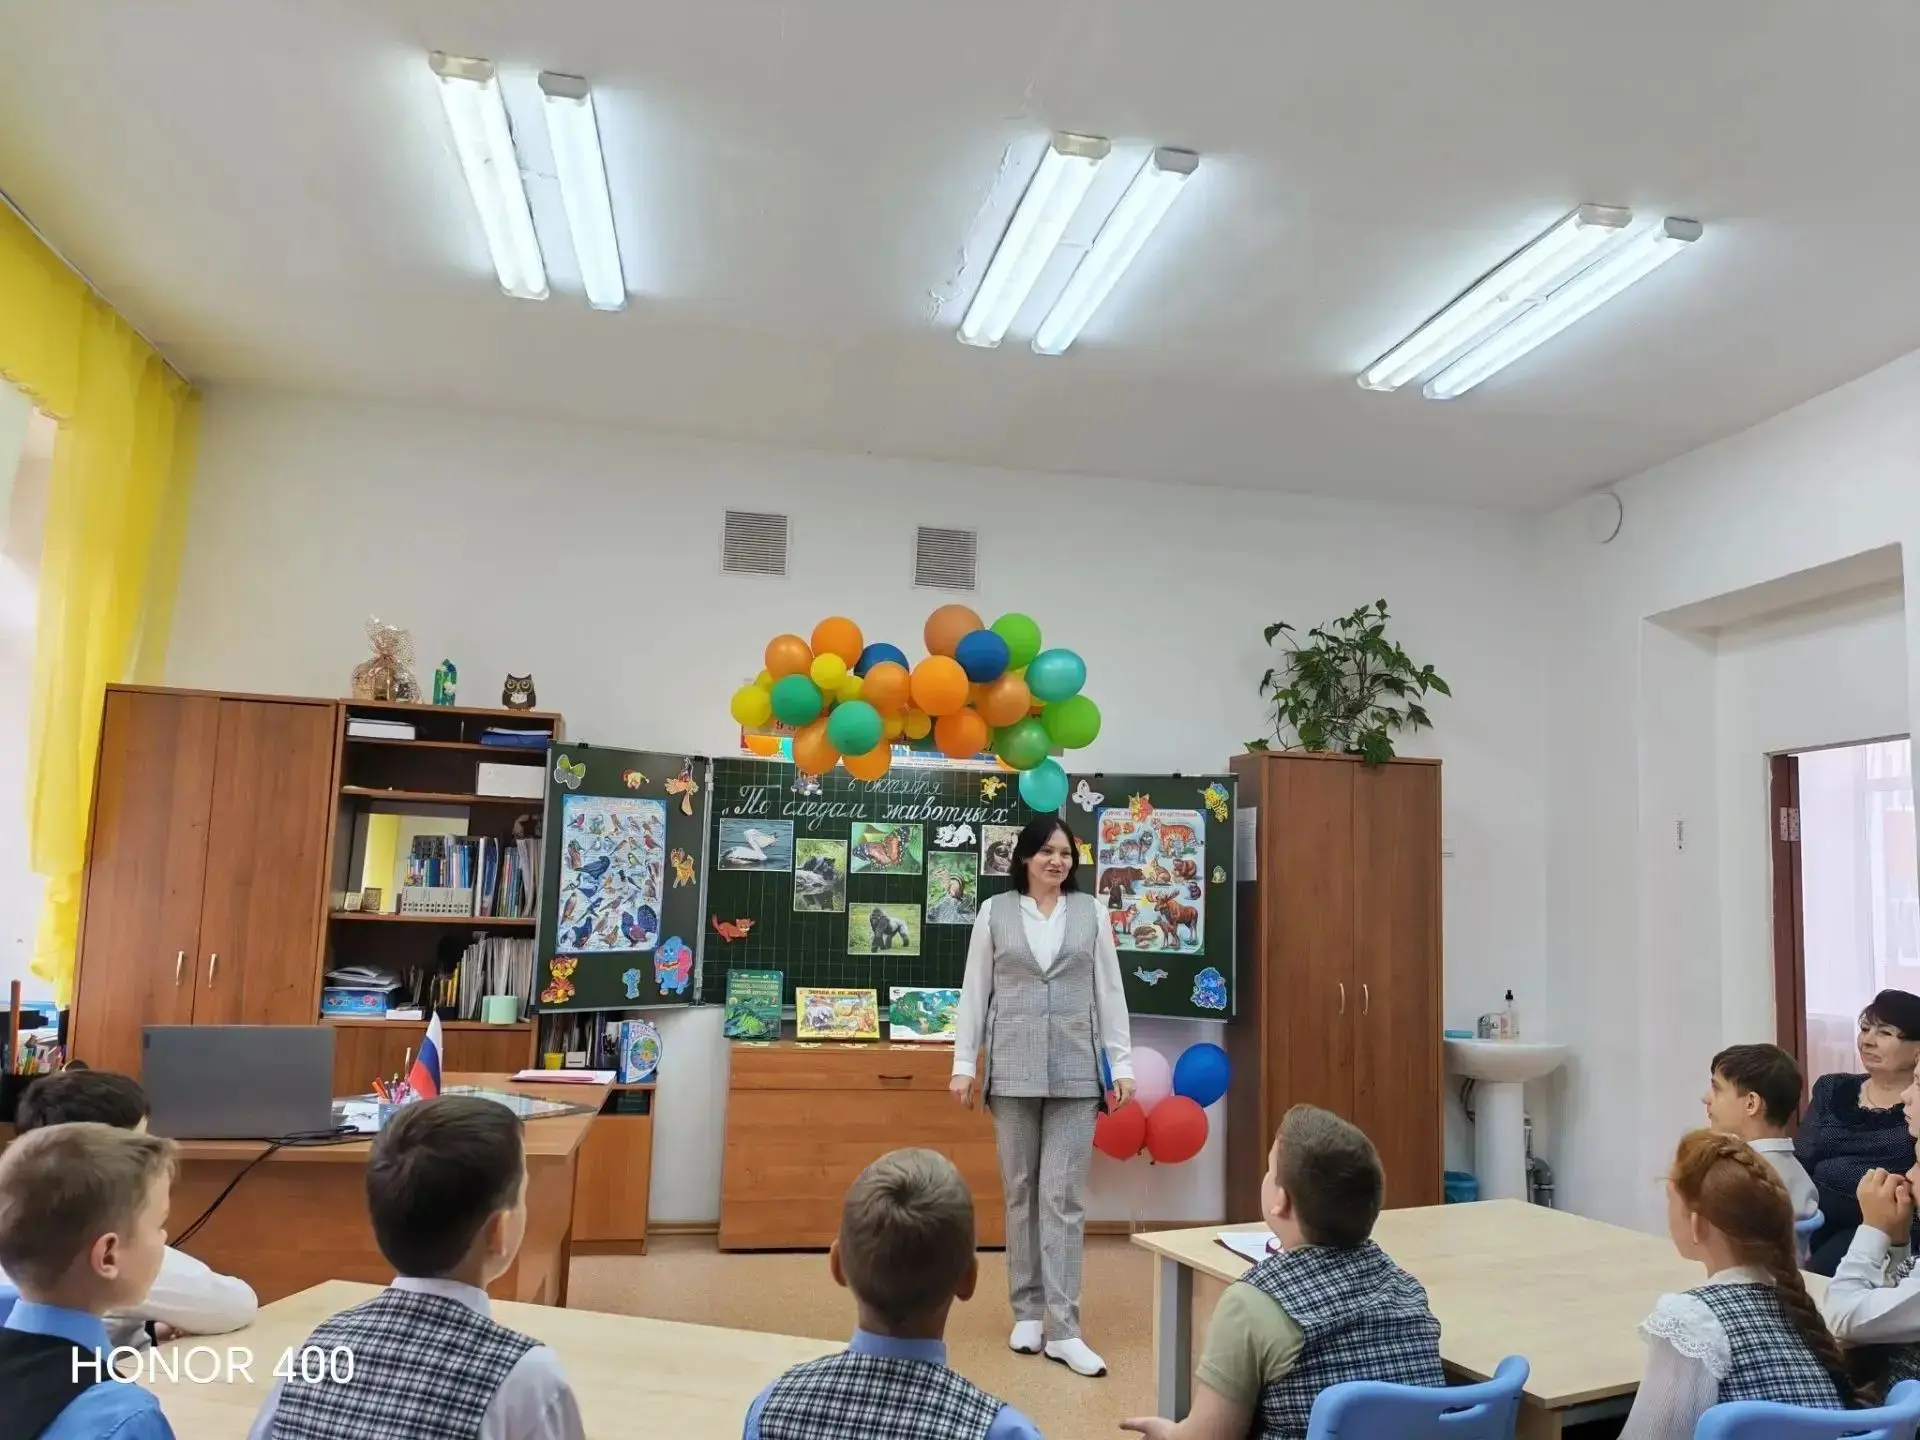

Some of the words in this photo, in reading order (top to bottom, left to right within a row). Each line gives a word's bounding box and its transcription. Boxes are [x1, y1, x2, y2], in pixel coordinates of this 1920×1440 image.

[847, 777, 858, 792] 6
[864, 773, 943, 801] октября
[782, 800, 867, 831] следам
